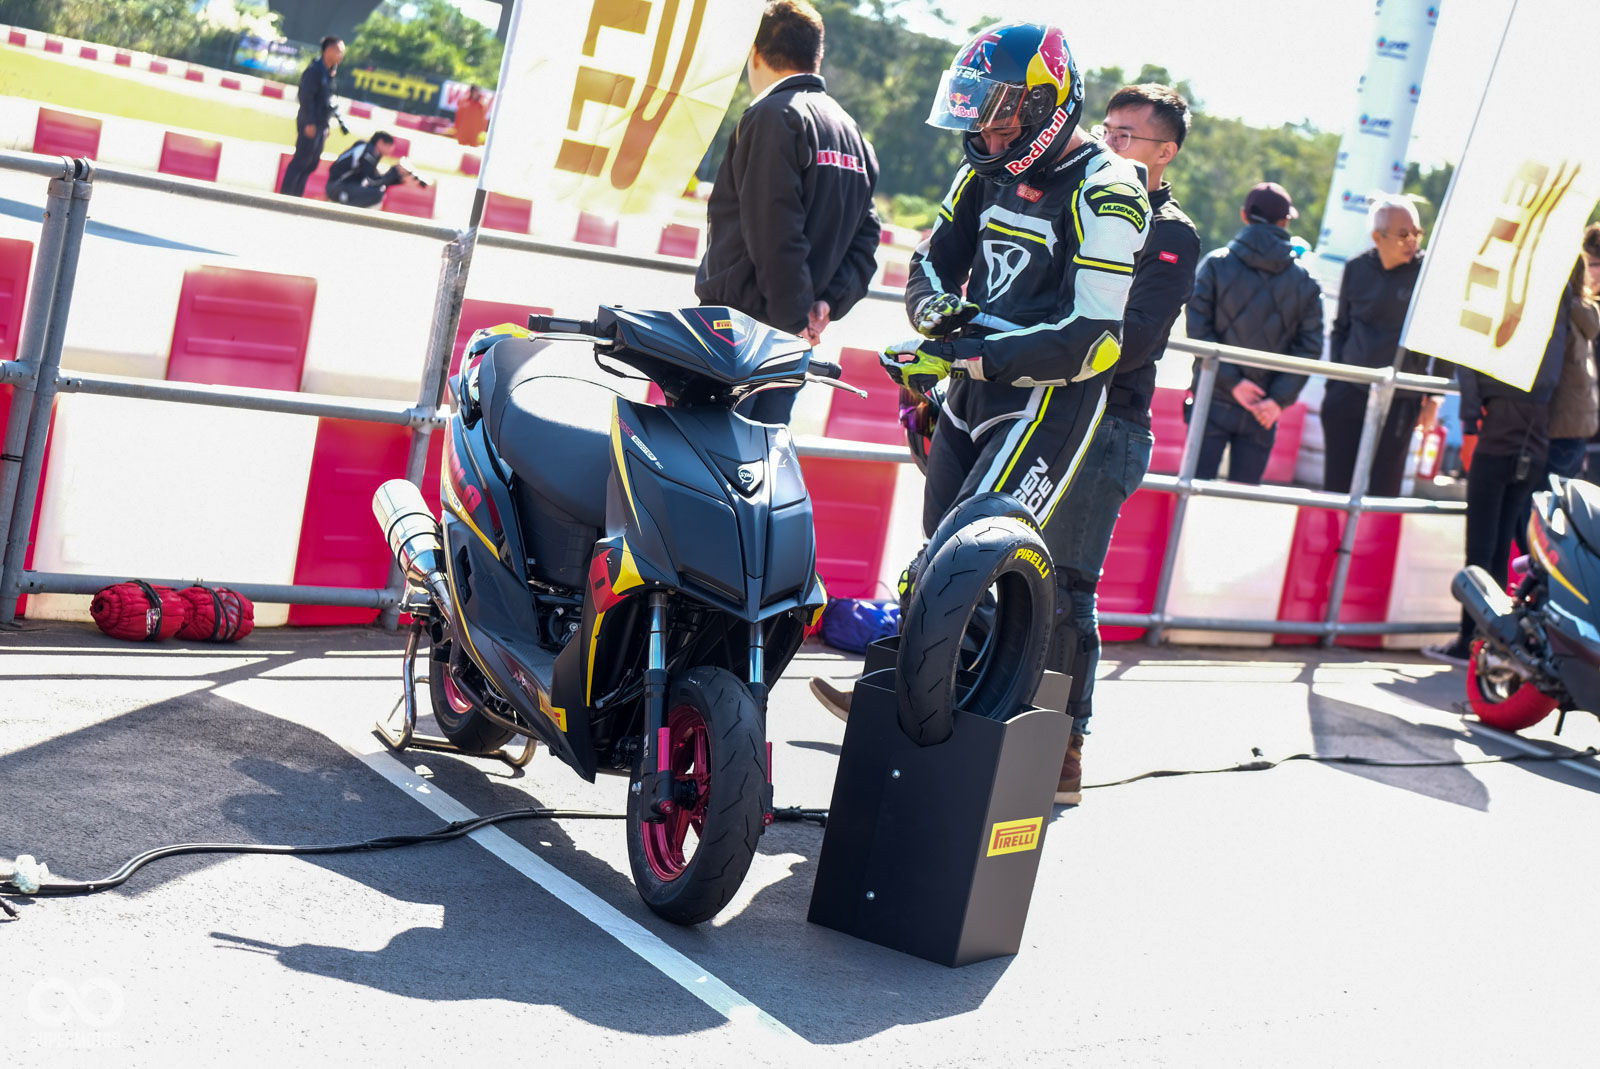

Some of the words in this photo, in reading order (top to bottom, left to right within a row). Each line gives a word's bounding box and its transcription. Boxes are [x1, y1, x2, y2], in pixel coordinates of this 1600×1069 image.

[1006, 141, 1045, 175] Red
[1037, 107, 1068, 149] Bull
[1012, 456, 1049, 505] GEN
[1027, 475, 1054, 514] CE
[1014, 548, 1050, 579] PIRELLI
[992, 823, 1038, 850] PIRELLI
